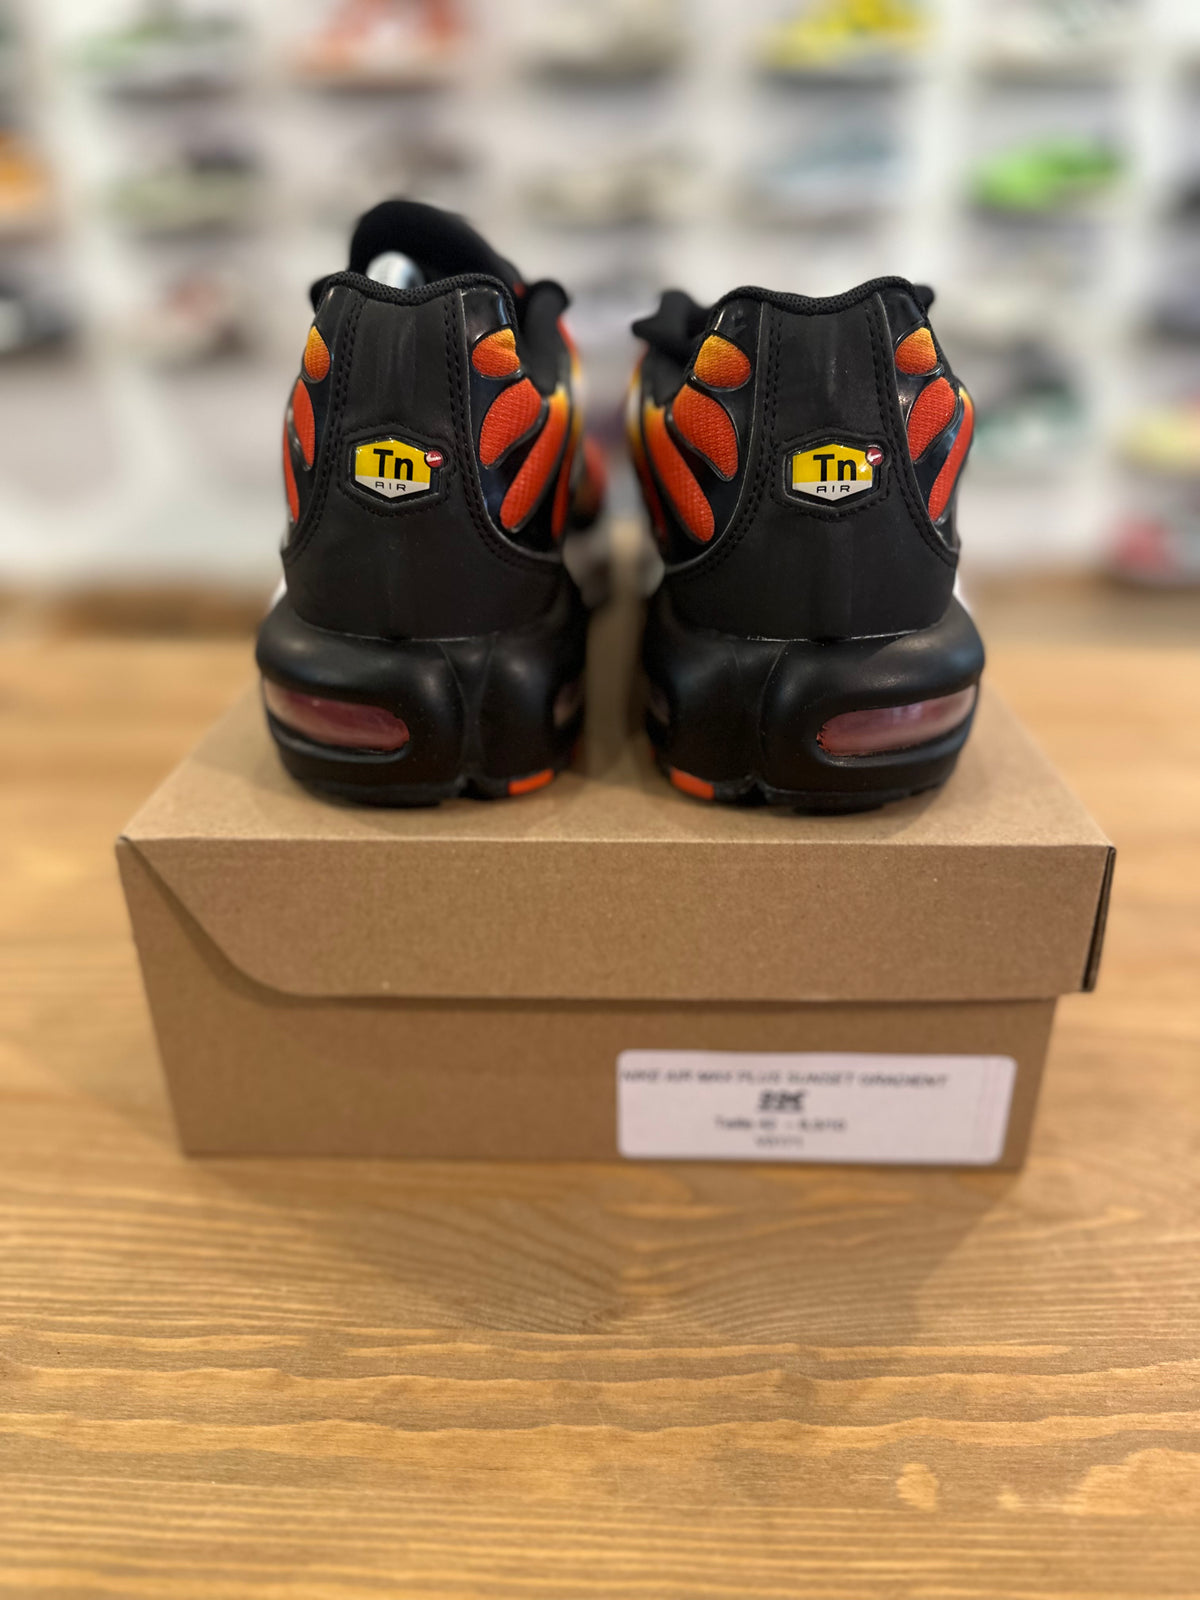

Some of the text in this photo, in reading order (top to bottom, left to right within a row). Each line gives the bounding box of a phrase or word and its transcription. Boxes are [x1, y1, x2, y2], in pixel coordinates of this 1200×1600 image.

[373, 448, 414, 481] Tn
[813, 454, 857, 482] Tn
[375, 481, 407, 491] AIR
[816, 485, 851, 493] AIR
